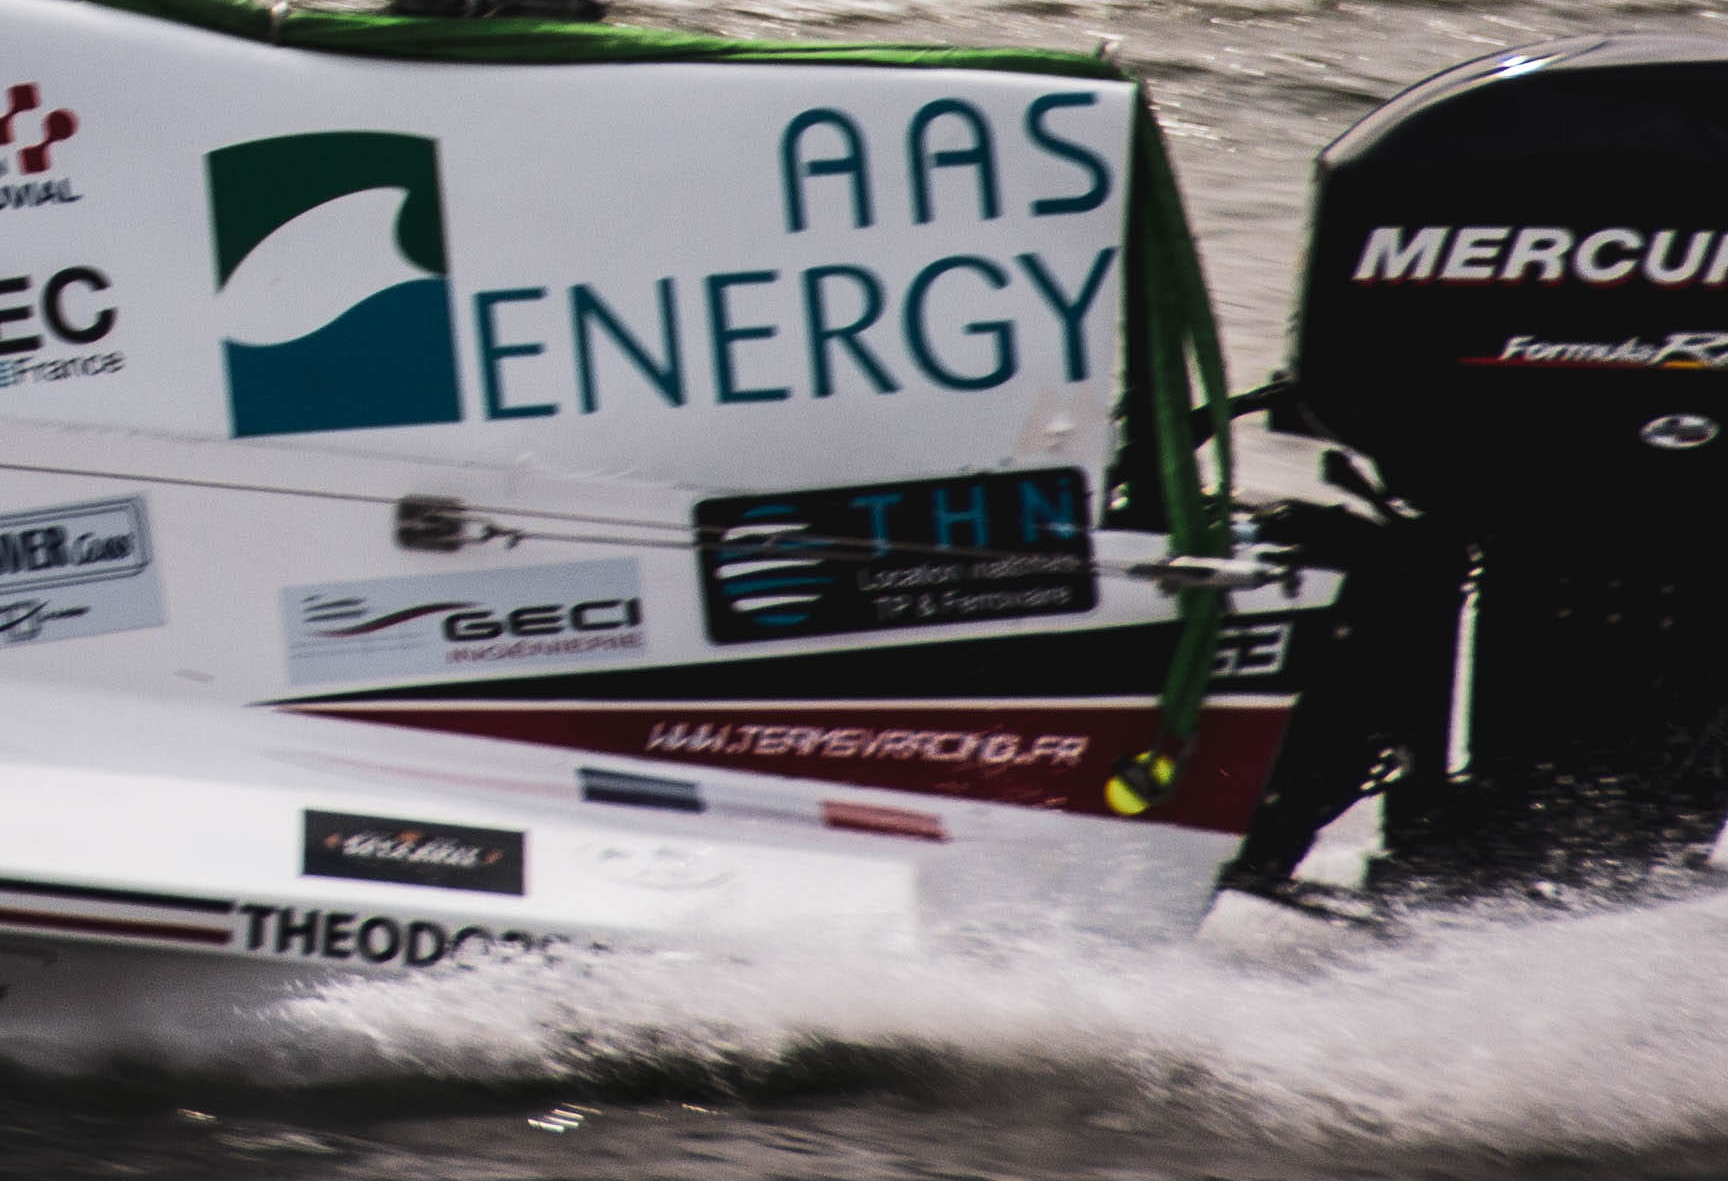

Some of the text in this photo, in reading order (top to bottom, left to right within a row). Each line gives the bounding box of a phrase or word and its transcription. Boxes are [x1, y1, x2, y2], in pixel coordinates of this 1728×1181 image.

[779, 91, 1115, 233] AAS
[473, 245, 1117, 420] ENERGY
[1497, 334, 1656, 363] Formula
[12, 351, 127, 385] France
[444, 598, 641, 642] GECI
